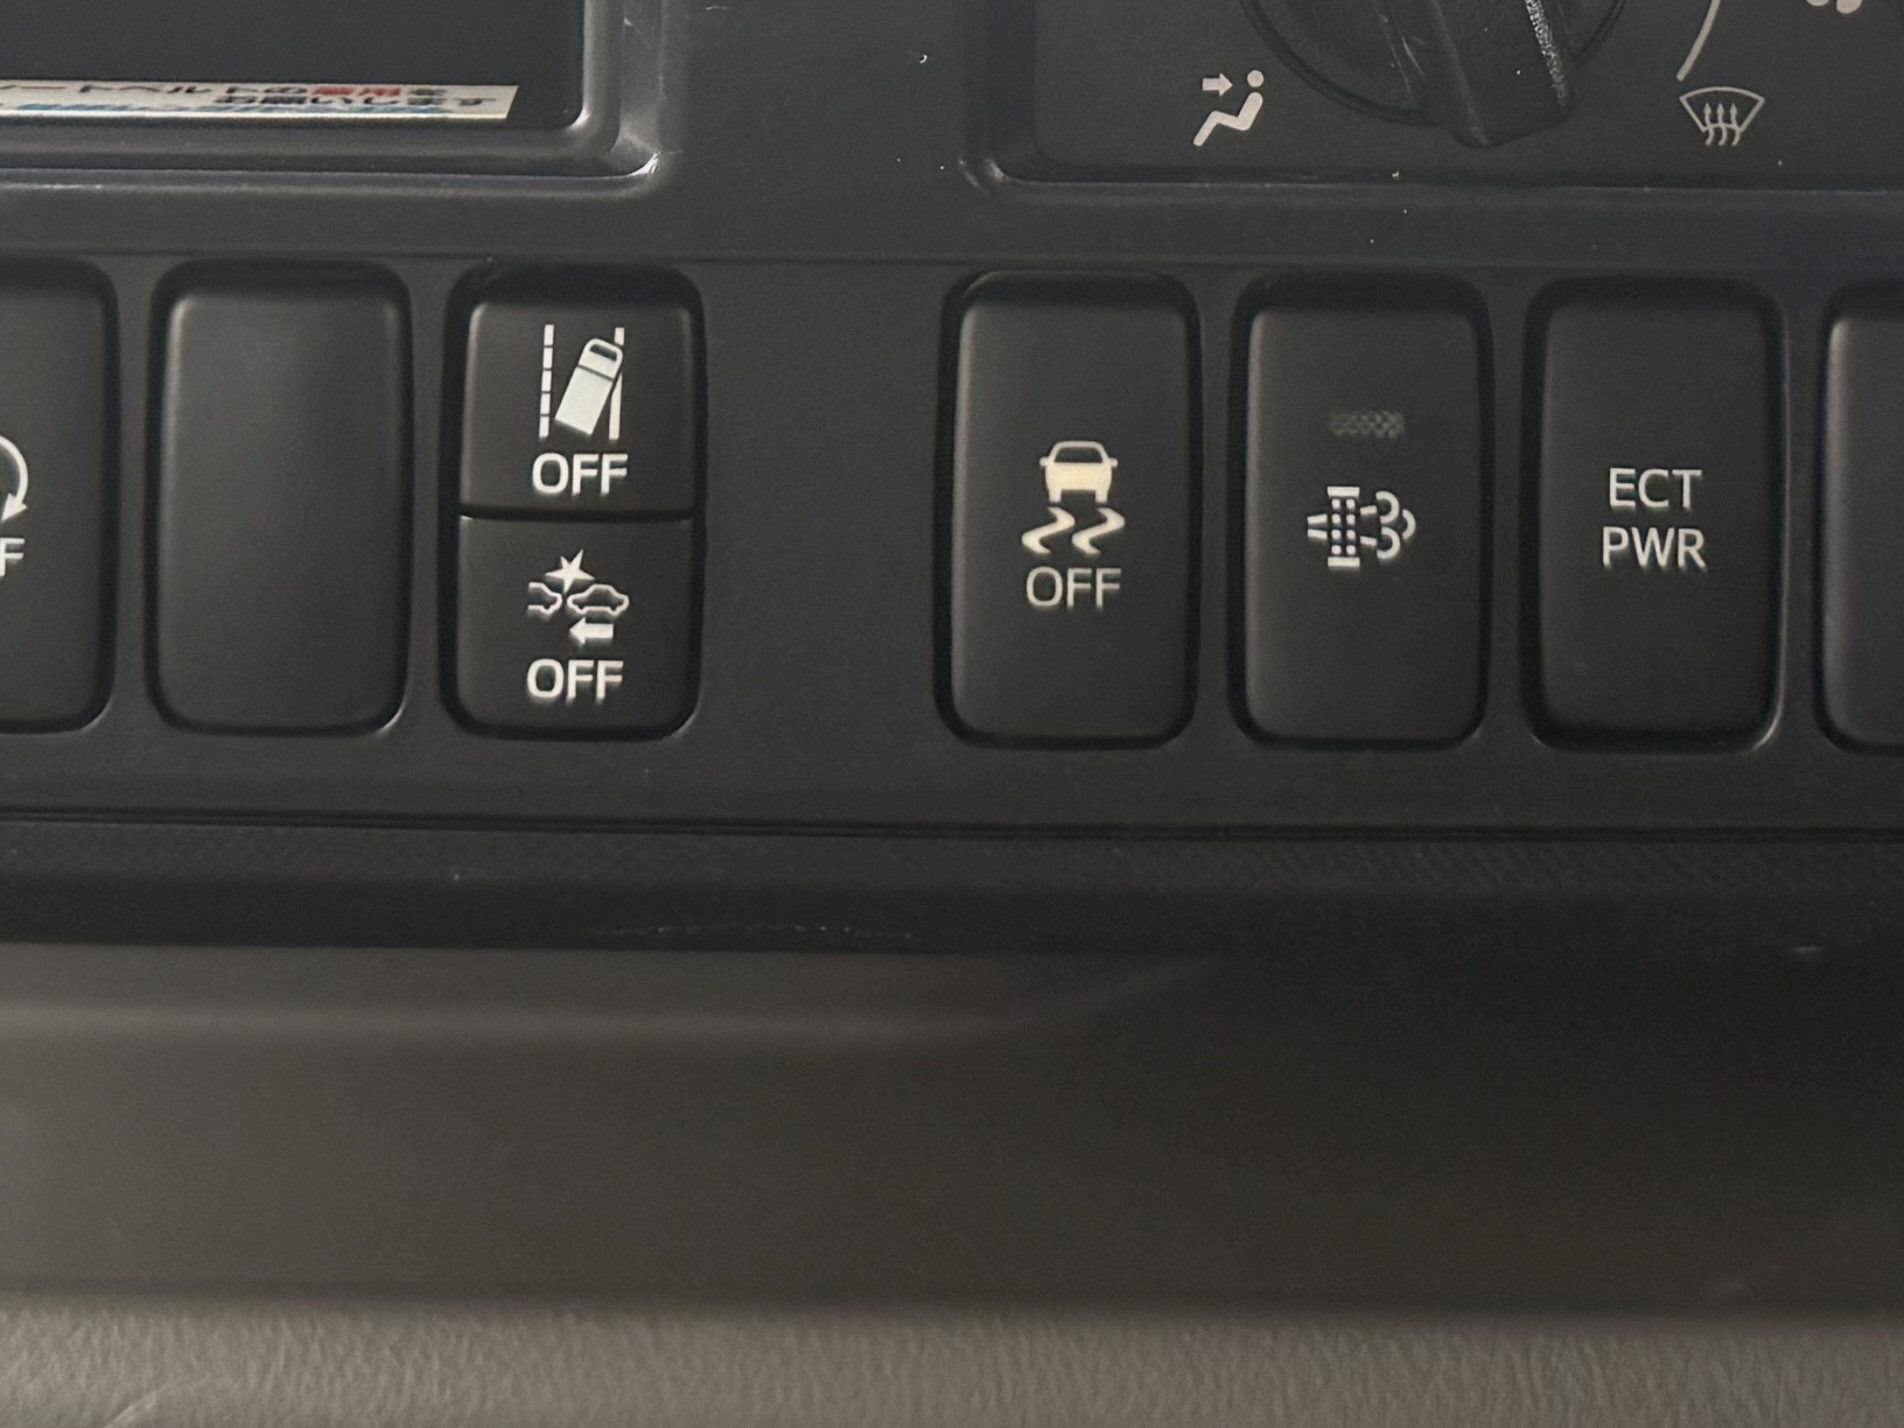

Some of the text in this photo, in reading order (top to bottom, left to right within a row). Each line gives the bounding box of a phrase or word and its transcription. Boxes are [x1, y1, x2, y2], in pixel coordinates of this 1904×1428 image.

[533, 453, 627, 494] OFF
[1610, 468, 1701, 508] ECT
[1603, 527, 1705, 567] PWR
[1027, 567, 1121, 607] OFF
[527, 659, 623, 699] OFF
